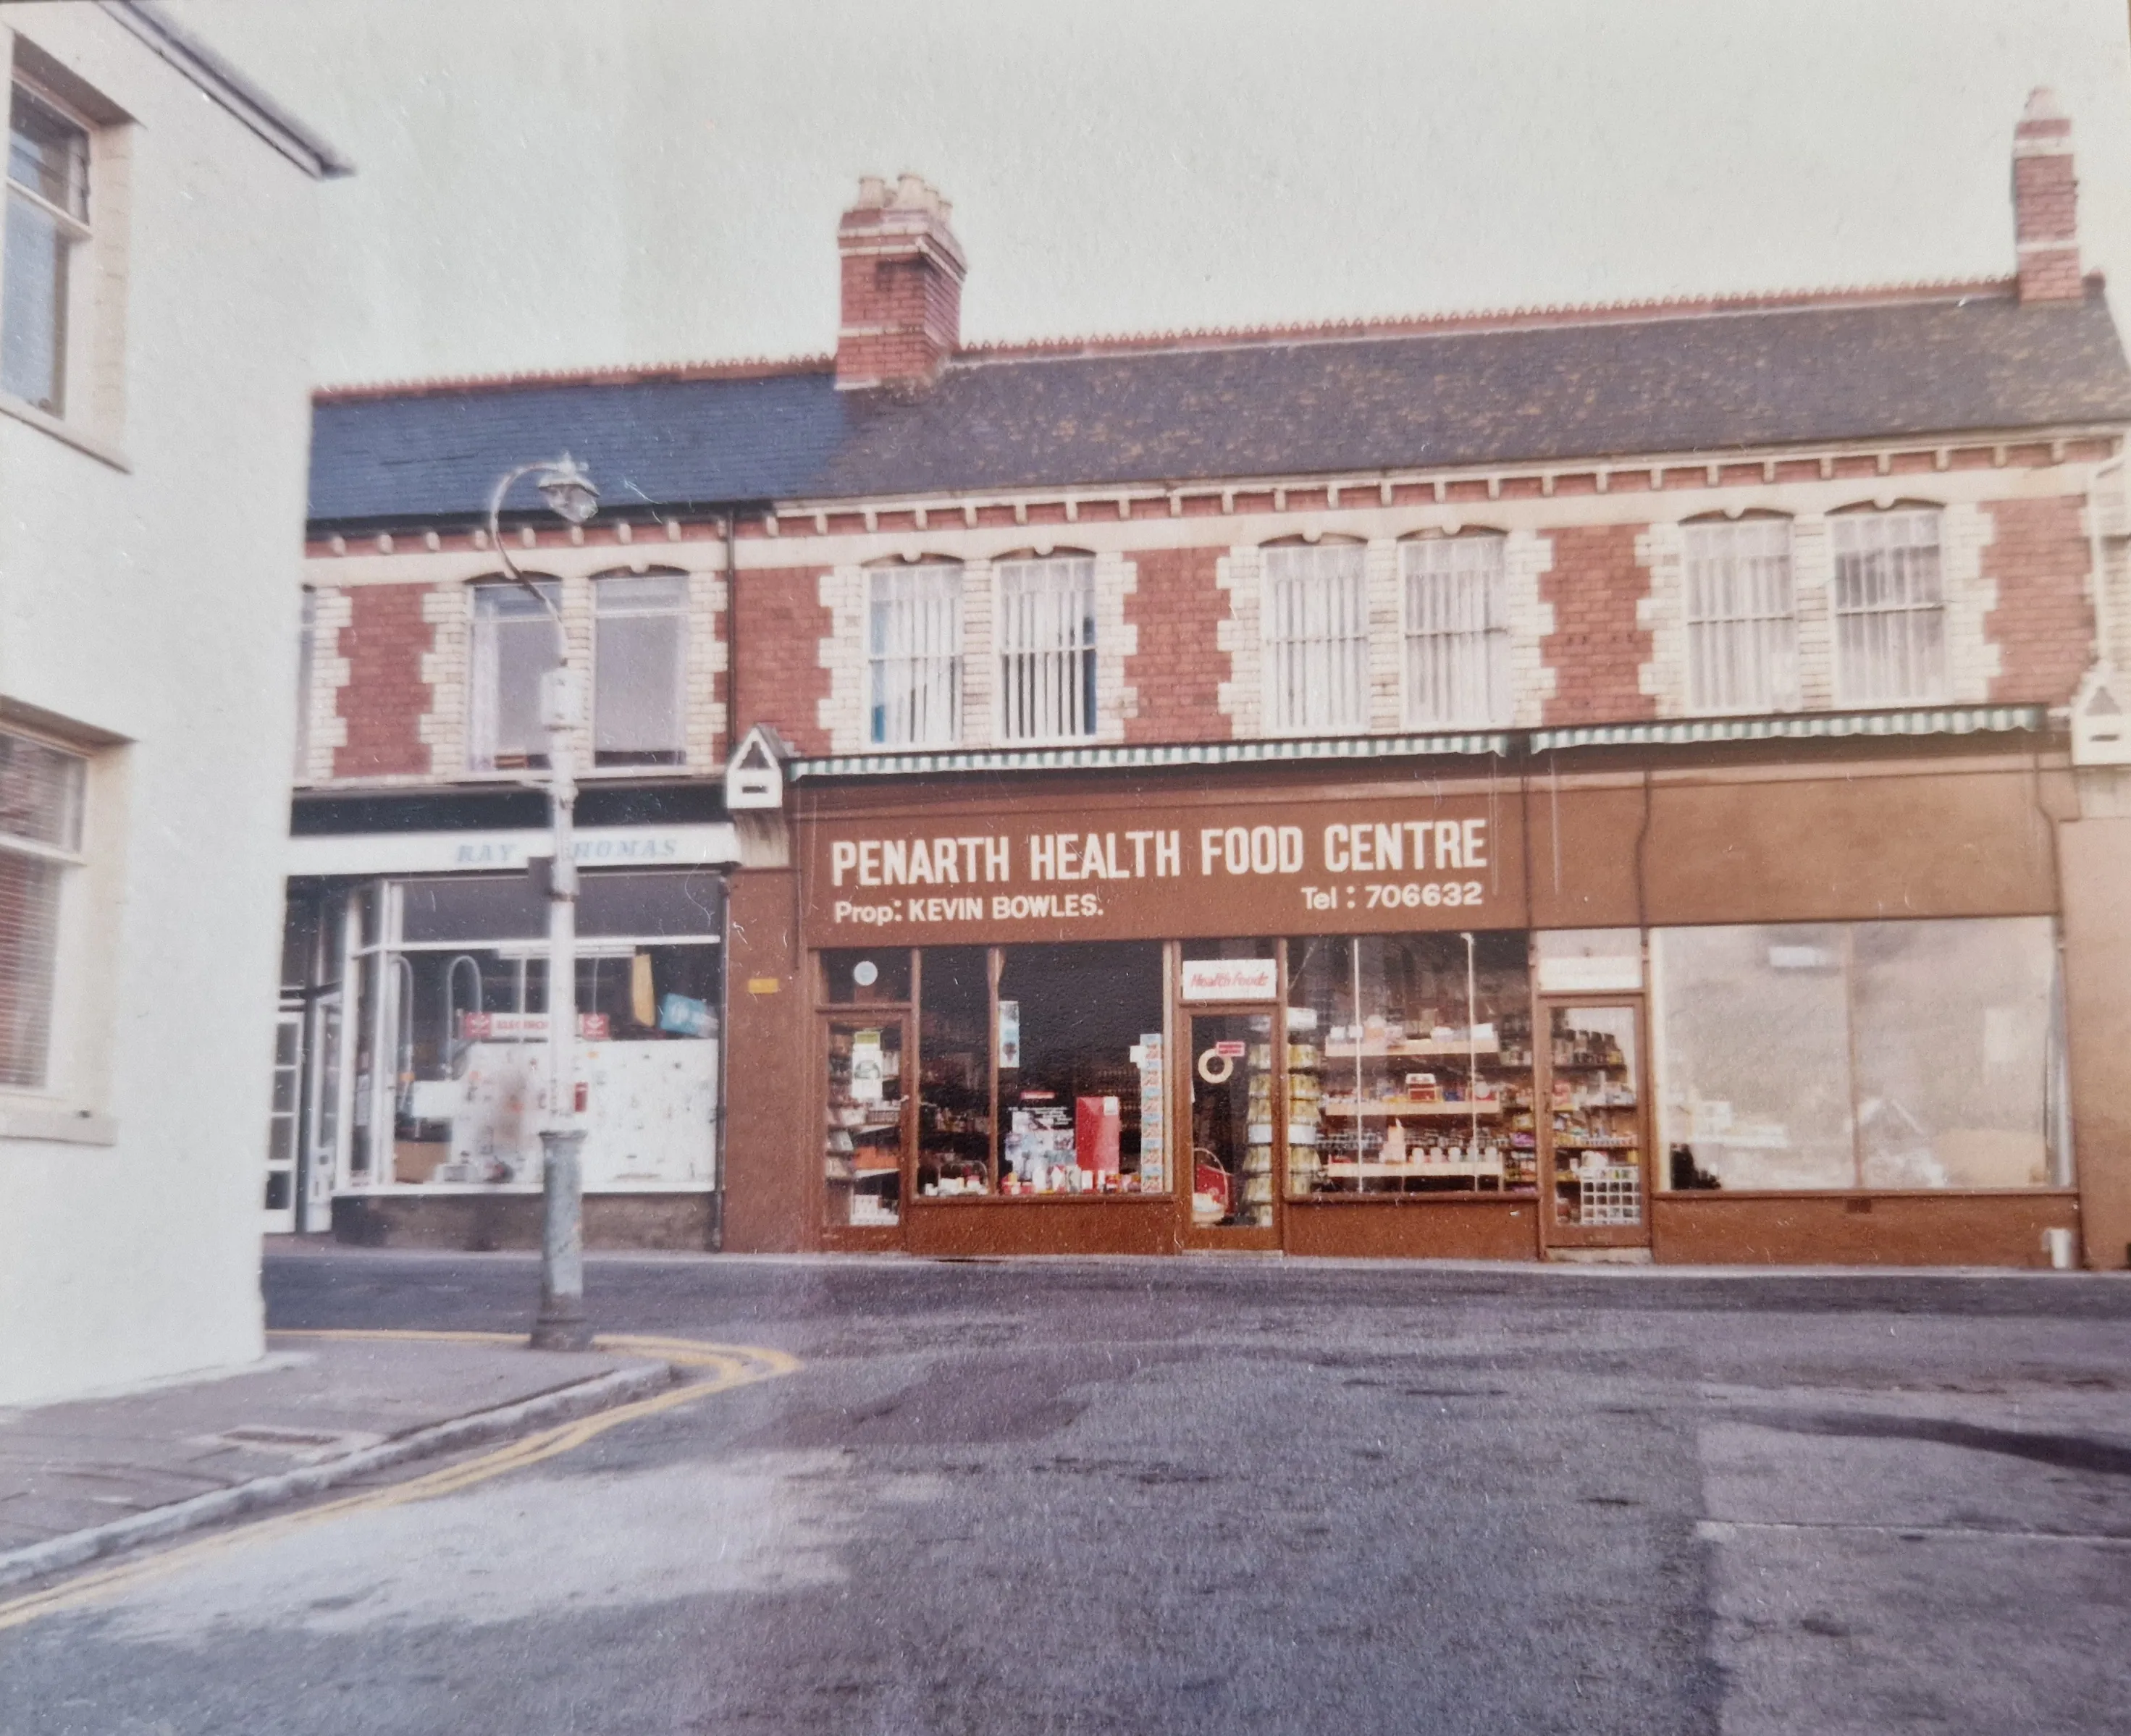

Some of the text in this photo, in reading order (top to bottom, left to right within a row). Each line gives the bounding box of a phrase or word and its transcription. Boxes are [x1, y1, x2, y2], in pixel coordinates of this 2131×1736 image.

[565, 839, 678, 859] HOMAS
[832, 818, 1487, 887] PENARTH HEALTH FOOD CENTRE
[834, 893, 1104, 927] Prop: KEVIN BOWLES.
[1365, 881, 1484, 909] 706632
